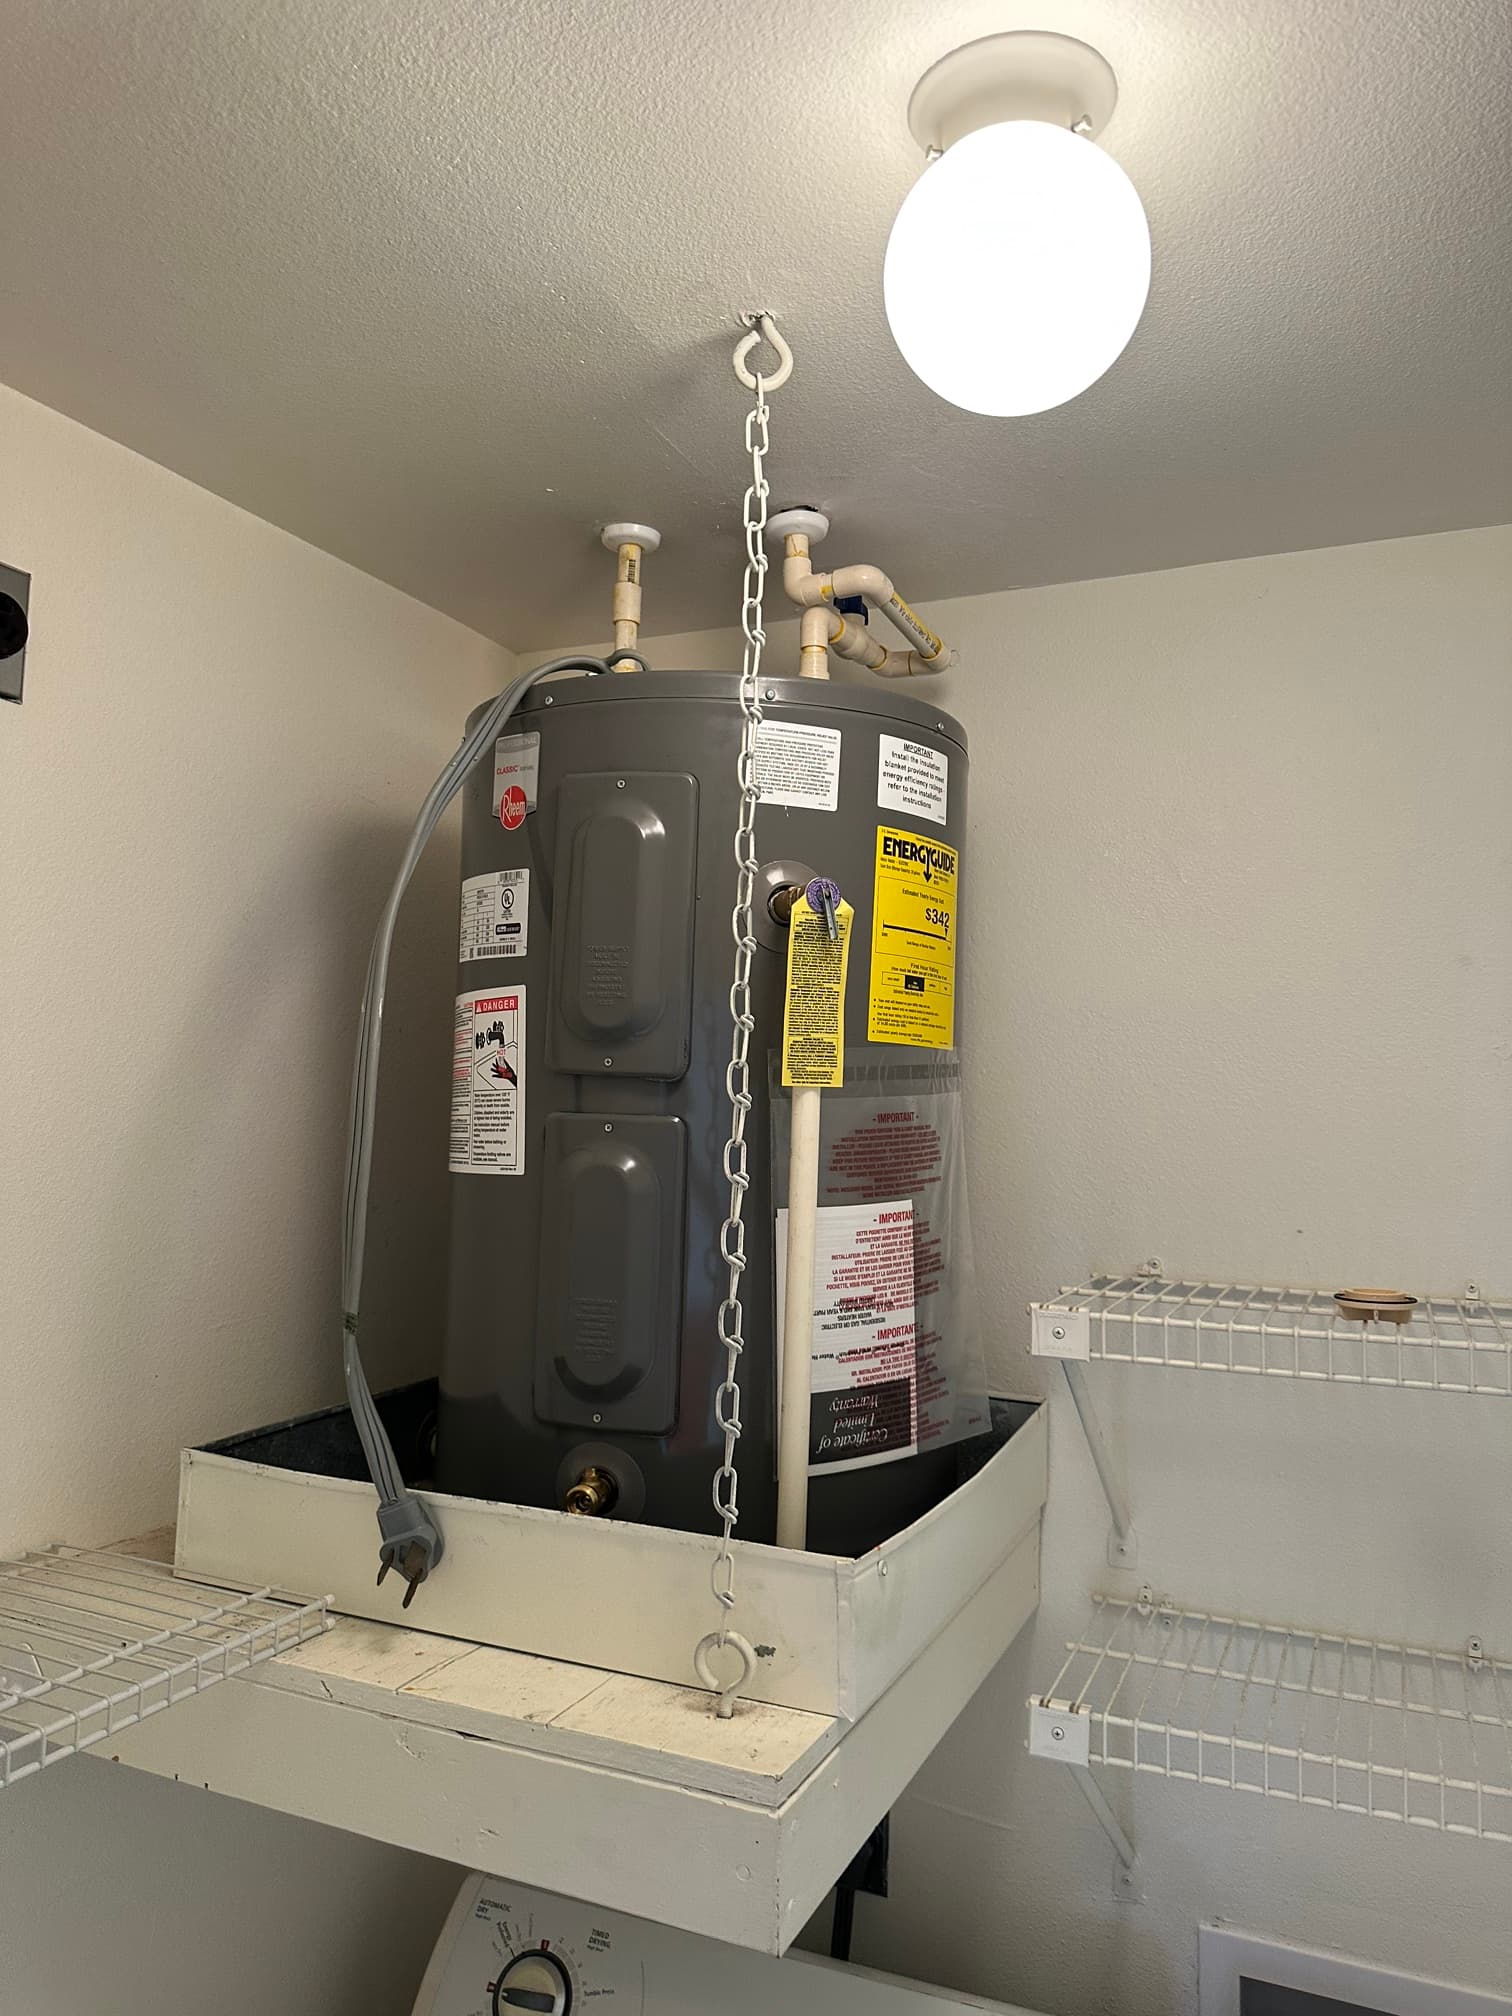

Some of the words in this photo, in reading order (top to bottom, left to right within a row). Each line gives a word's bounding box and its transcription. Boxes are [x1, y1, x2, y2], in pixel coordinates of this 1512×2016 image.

[892, 751, 909, 760] Install
[910, 756, 918, 764] the
[904, 743, 933, 758] IMPORTANT
[496, 764, 518, 775] CLASSIC
[885, 760, 906, 770] blanket
[908, 767, 929, 777] provided
[883, 771, 903, 782] energy
[904, 776, 928, 789] efficiency
[502, 786, 526, 823] Rheem
[903, 795, 931, 808] instructions
[883, 837, 954, 875] ENERGYGUIDE
[483, 999, 514, 1011] DANGER
[877, 1112, 915, 1123] IMPORTANT
[829, 1394, 878, 1412] Warranty
[833, 1412, 875, 1433] Limited
[816, 1435, 831, 1454] of
[833, 1428, 888, 1447] Certificate
[476, 1904, 489, 1914] DRY
[479, 1897, 512, 1913] AUTOMATIC
[591, 1927, 610, 1939] TIMED
[588, 1936, 611, 1949] DRYING
